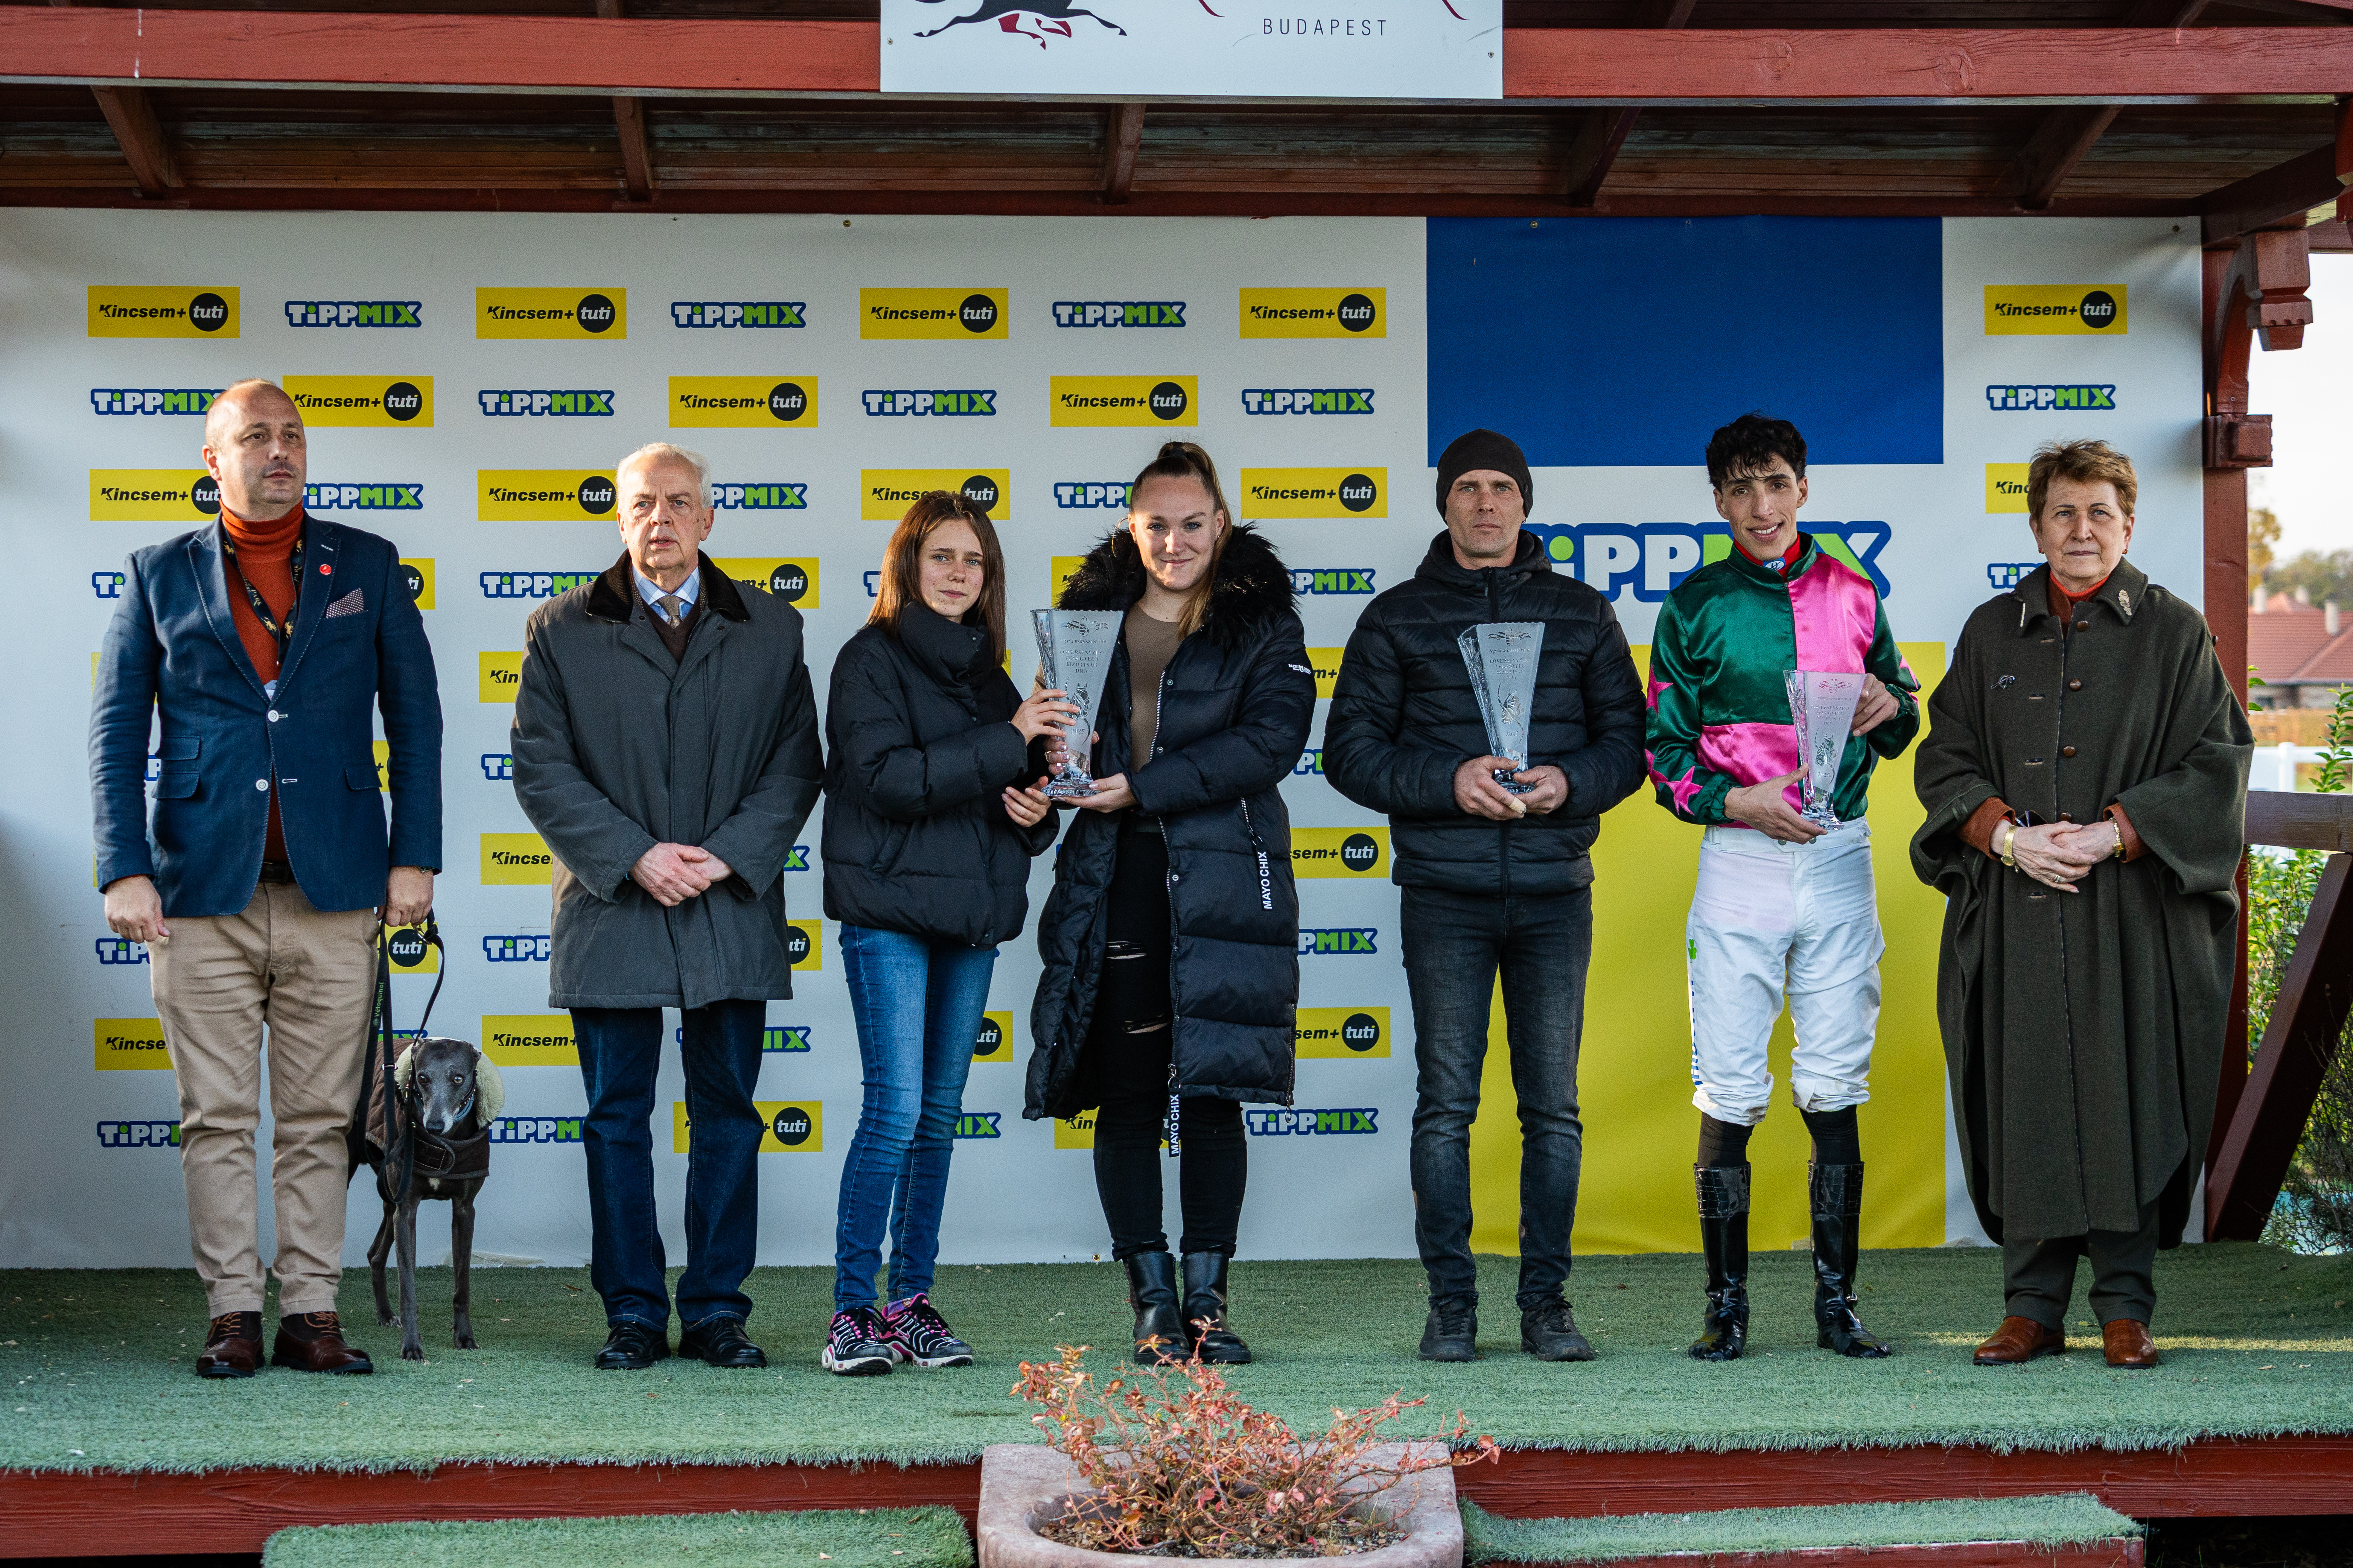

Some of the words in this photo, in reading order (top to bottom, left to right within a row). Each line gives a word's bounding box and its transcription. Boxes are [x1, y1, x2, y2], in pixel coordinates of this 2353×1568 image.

[1263, 18, 1386, 36] BUDAPEST
[193, 305, 224, 318] tuti
[287, 303, 420, 325] TiPPMIX
[581, 306, 611, 319] tuti
[673, 304, 805, 326] TiPPMIX
[963, 306, 993, 319] tuti
[1055, 303, 1184, 326] TiPPMIX
[1342, 306, 1371, 319] tuti
[2084, 303, 2112, 316] tuti
[387, 394, 418, 408] tuti
[481, 392, 613, 414] TiPPMIX
[772, 395, 802, 408] tuti
[864, 392, 995, 414] TiPPMIX
[1153, 394, 1183, 407] tuti
[1243, 391, 1373, 413] TiPPMIX
[1989, 387, 2114, 409] TiPPMIX
[195, 488, 221, 502] tut
[302, 486, 422, 508] iPPMIX
[582, 488, 612, 501] tuti
[711, 485, 806, 508] PPMIX
[872, 488, 929, 502] Kincs
[964, 487, 994, 500] tuti
[1056, 485, 1133, 507] TiPP
[1342, 486, 1372, 499] tuti
[408, 576, 420, 590] ti
[482, 574, 600, 596] TiPPM
[774, 576, 804, 589] tuti
[1297, 570, 1374, 593] PMIX
[492, 852, 551, 865] Kincse
[1291, 849, 1338, 859] sem+
[1345, 845, 1374, 859] tuti
[1258, 852, 1269, 876] CHIX
[1262, 879, 1272, 909] MAYO
[392, 941, 422, 954] tuti
[485, 938, 551, 960] TiPP
[1298, 931, 1374, 953] PMIX
[976, 1030, 997, 1043] uti
[1295, 1029, 1339, 1039] sem+
[1346, 1025, 1375, 1039] tuti
[106, 1037, 166, 1050] Kincse
[1170, 1095, 1179, 1121] CHIX
[489, 1119, 580, 1141] TiPPM
[777, 1119, 807, 1133] tuti
[1248, 1111, 1377, 1133] TiPPMIX
[100, 1123, 179, 1145] TiPP
[1170, 1124, 1180, 1154] MAYO
